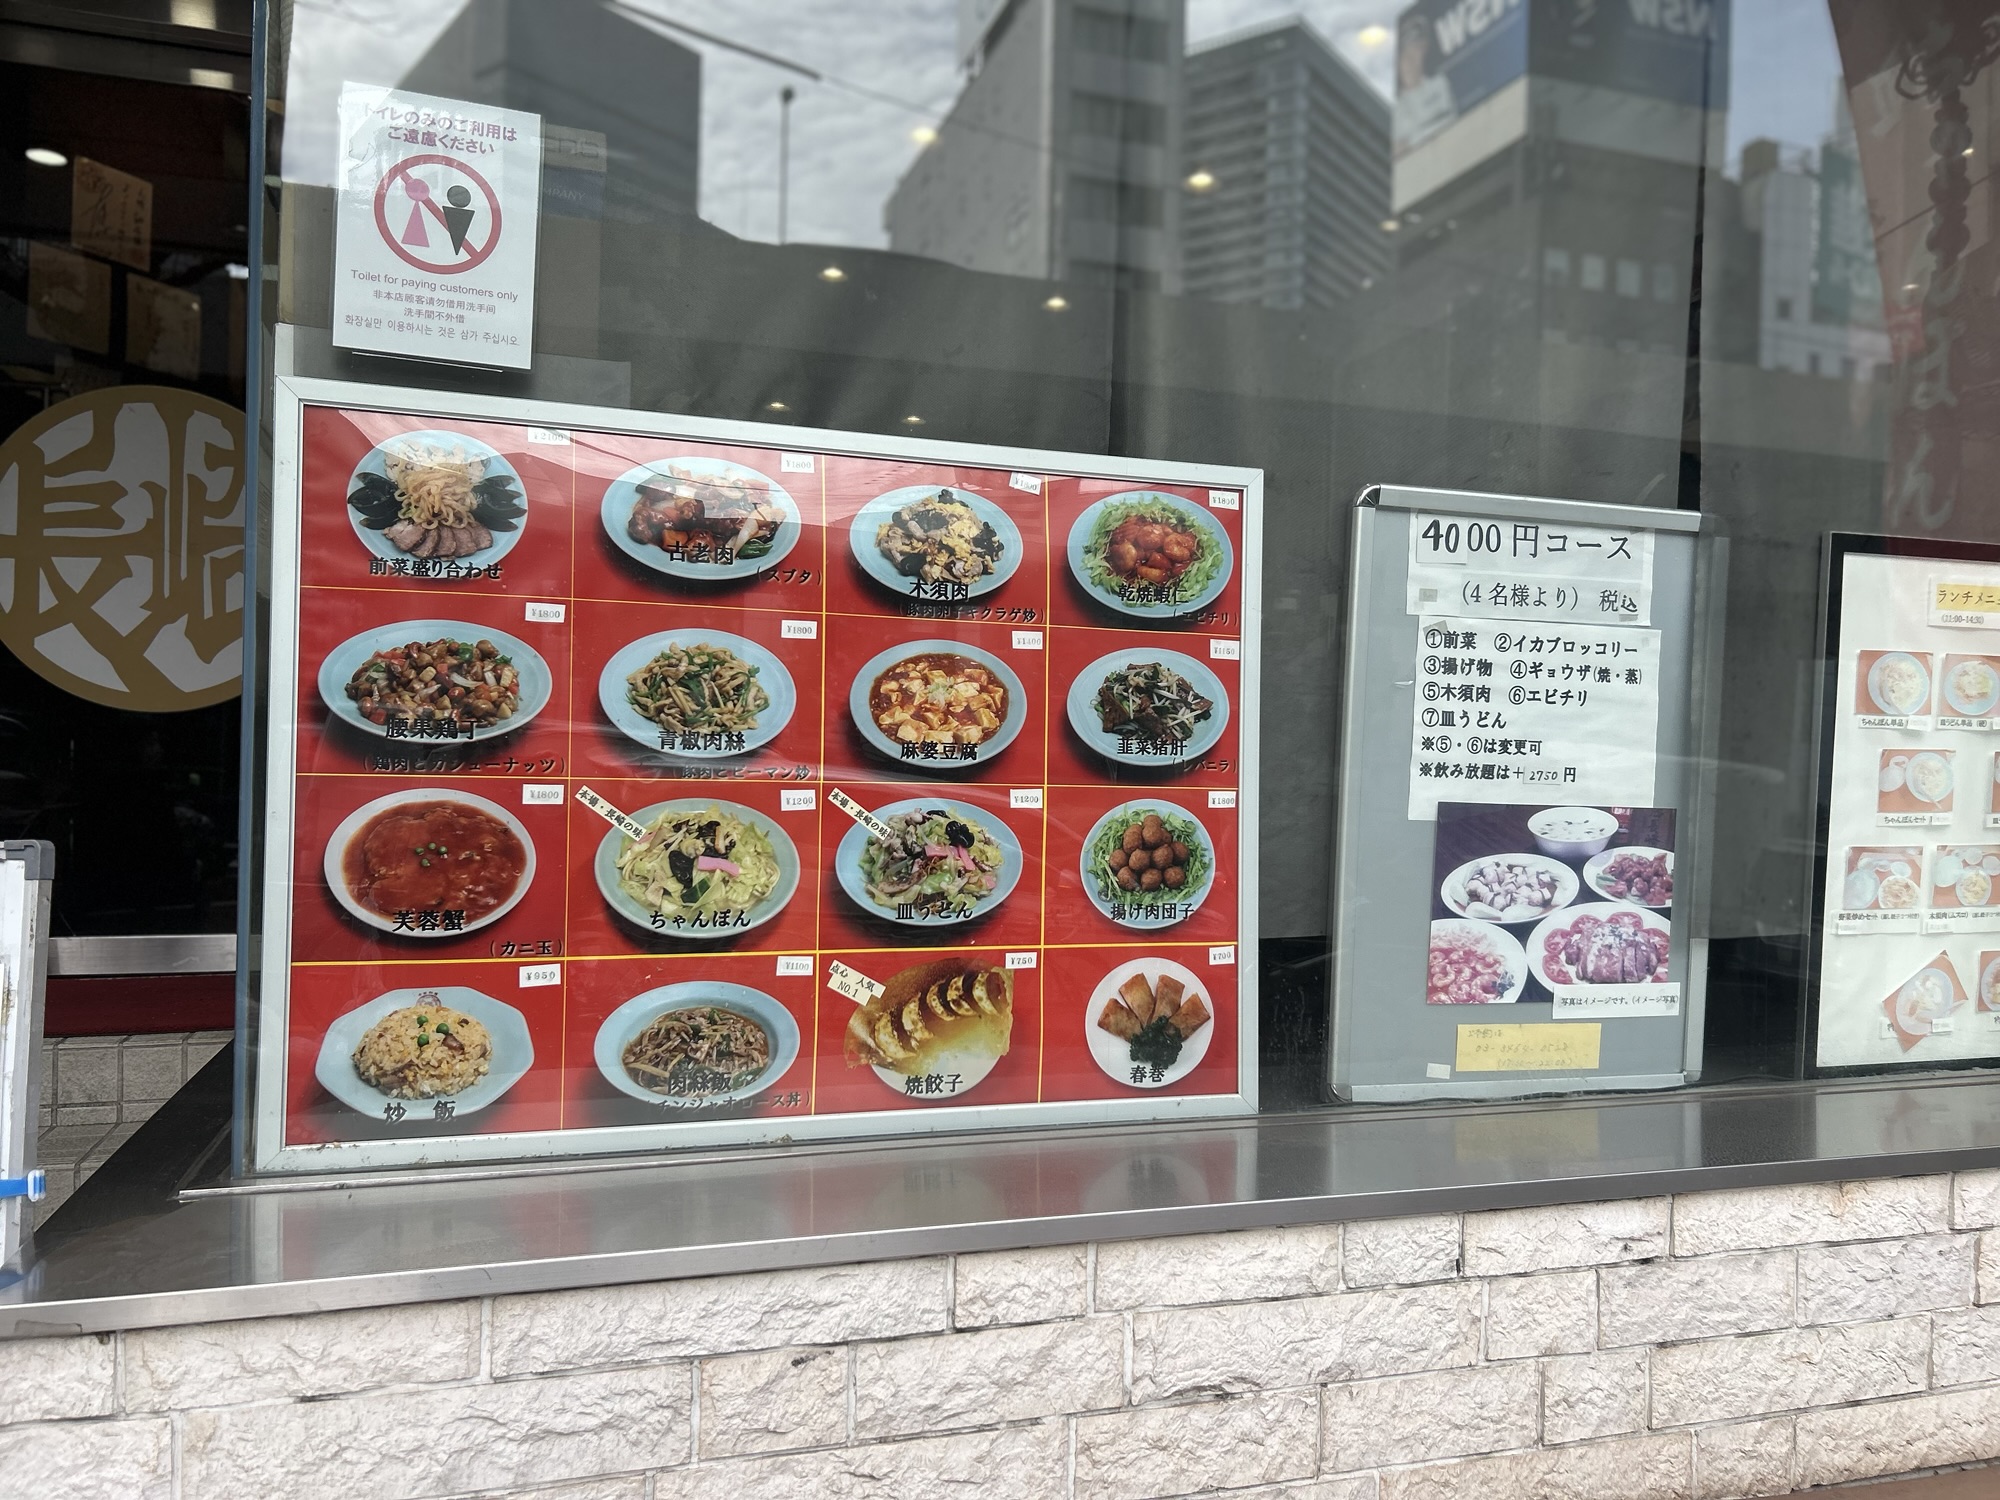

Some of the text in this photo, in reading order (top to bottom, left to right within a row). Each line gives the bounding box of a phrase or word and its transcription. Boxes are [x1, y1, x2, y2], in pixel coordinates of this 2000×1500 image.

[363, 103, 518, 142] トイレのみのご利用は
[387, 124, 495, 154] ご遠慮ください
[350, 269, 519, 303] Toilet for paying customers only
[373, 289, 496, 315] 非本店顾客请勿借用洗手间
[403, 306, 465, 324] 洗手間不外借
[344, 313, 382, 329] 화장실만
[387, 320, 433, 337] 이용하시는
[438, 326, 455, 339] 것은
[460, 329, 478, 342] 삼가
[785, 459, 812, 470] ¥1800
[1421, 518, 1632, 560] 4000円コース
[667, 540, 735, 566] 古老肉
[369, 556, 503, 580] 前菜盛り合わせ
[908, 578, 970, 601] 木須肉
[1118, 584, 1189, 605] 乾焼蝦仁
[1461, 580, 1639, 613] (4名様より) 税込
[531, 608, 561, 619] ¥1800
[786, 624, 813, 635] ¥1800
[1425, 628, 1638, 659] ①前菜 ②イカブロッコリー
[1423, 654, 1494, 677] ③揚げ物
[1422, 681, 1588, 707] ⑤木須肉 ⑥エビチリ
[384, 717, 479, 741] 腰果鶏丁
[1421, 707, 1508, 730] ⑦皿うどん
[657, 729, 746, 752] 青椒肉絲
[899, 740, 979, 761] 麻婆豆腐
[529, 789, 560, 800] ¥1800
[785, 796, 814, 807] ¥1200
[1013, 795, 1040, 804] ¥1200
[1211, 797, 1236, 806] ¥1800
[578, 788, 645, 841] 本場・長崎の味
[830, 790, 890, 839] 本場・長崎の味
[392, 908, 466, 933] 芙蓉蟹
[649, 908, 752, 930] ちゃんぽん
[895, 900, 973, 921] 皿うどん
[1110, 902, 1195, 920] 揚げ肉団子
[488, 938, 565, 957] (カニ玉)
[1212, 951, 1232, 961] ¥700
[784, 961, 810, 972] ¥1100
[1010, 956, 1033, 965] ¥750
[526, 970, 557, 981] ¥950
[830, 963, 876, 993] 点心 人気
[836, 980, 860, 999] NO.1
[904, 1073, 964, 1096] 焼餃子
[1129, 1064, 1166, 1084] 春巻
